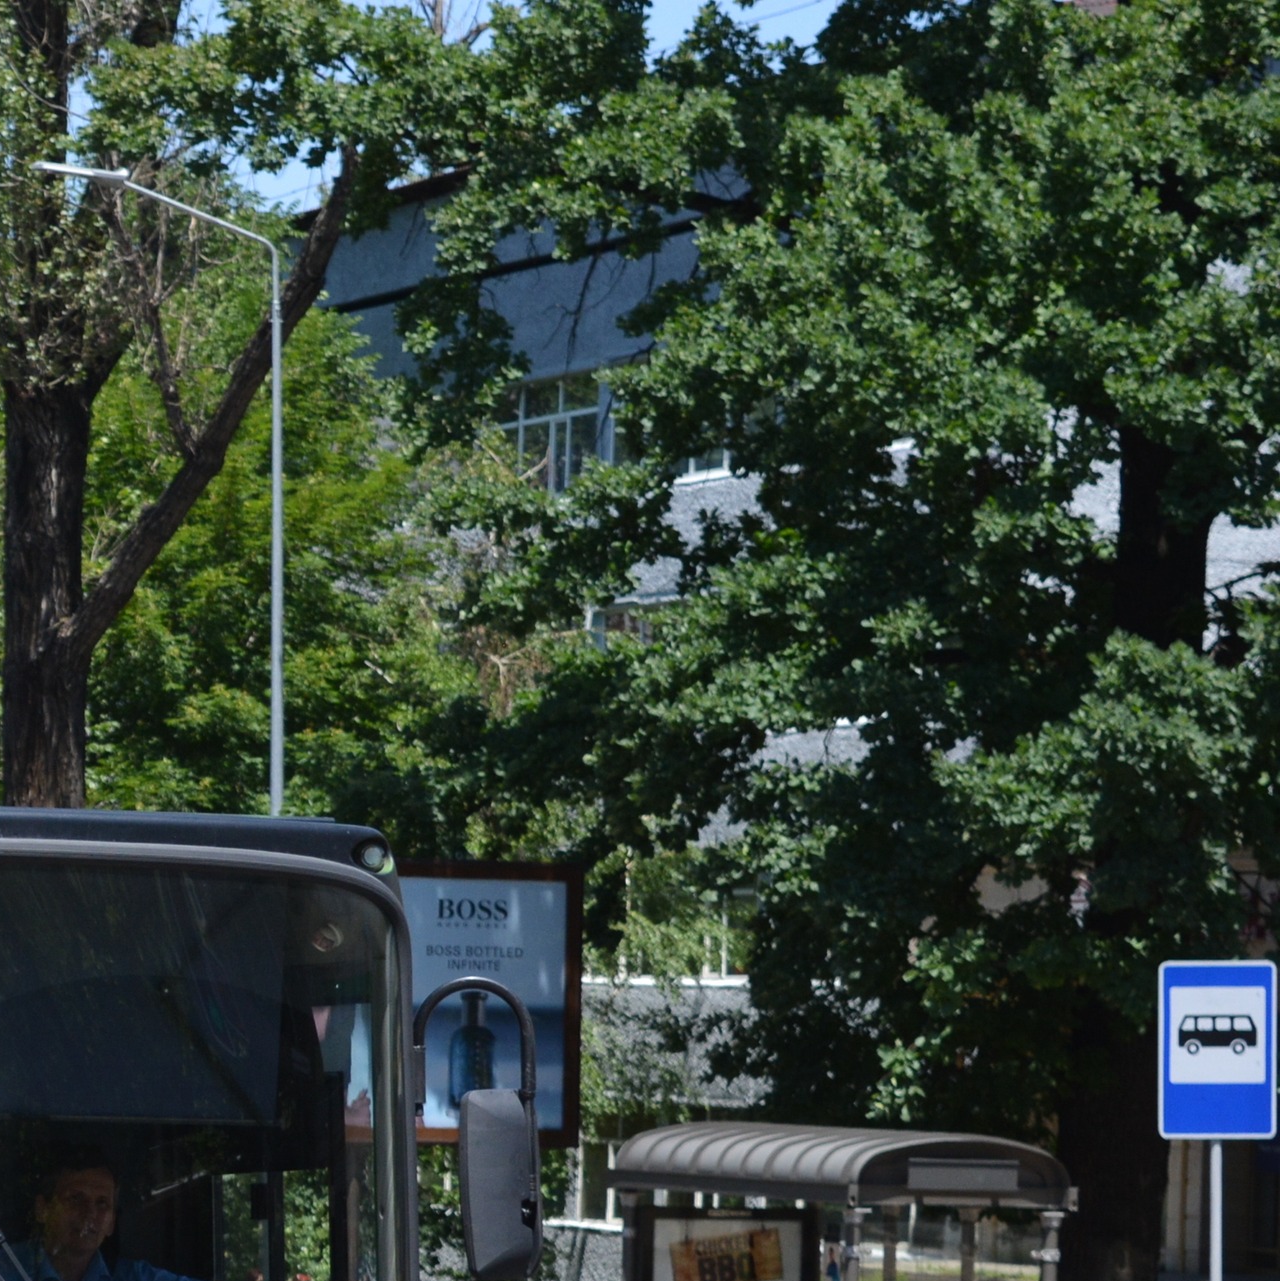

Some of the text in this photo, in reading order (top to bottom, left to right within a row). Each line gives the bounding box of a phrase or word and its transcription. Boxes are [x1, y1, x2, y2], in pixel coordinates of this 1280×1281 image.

[438, 899, 508, 921] BOSS
[426, 945, 524, 958] BOSS BOTTLED
[448, 960, 500, 971] INFINITE
